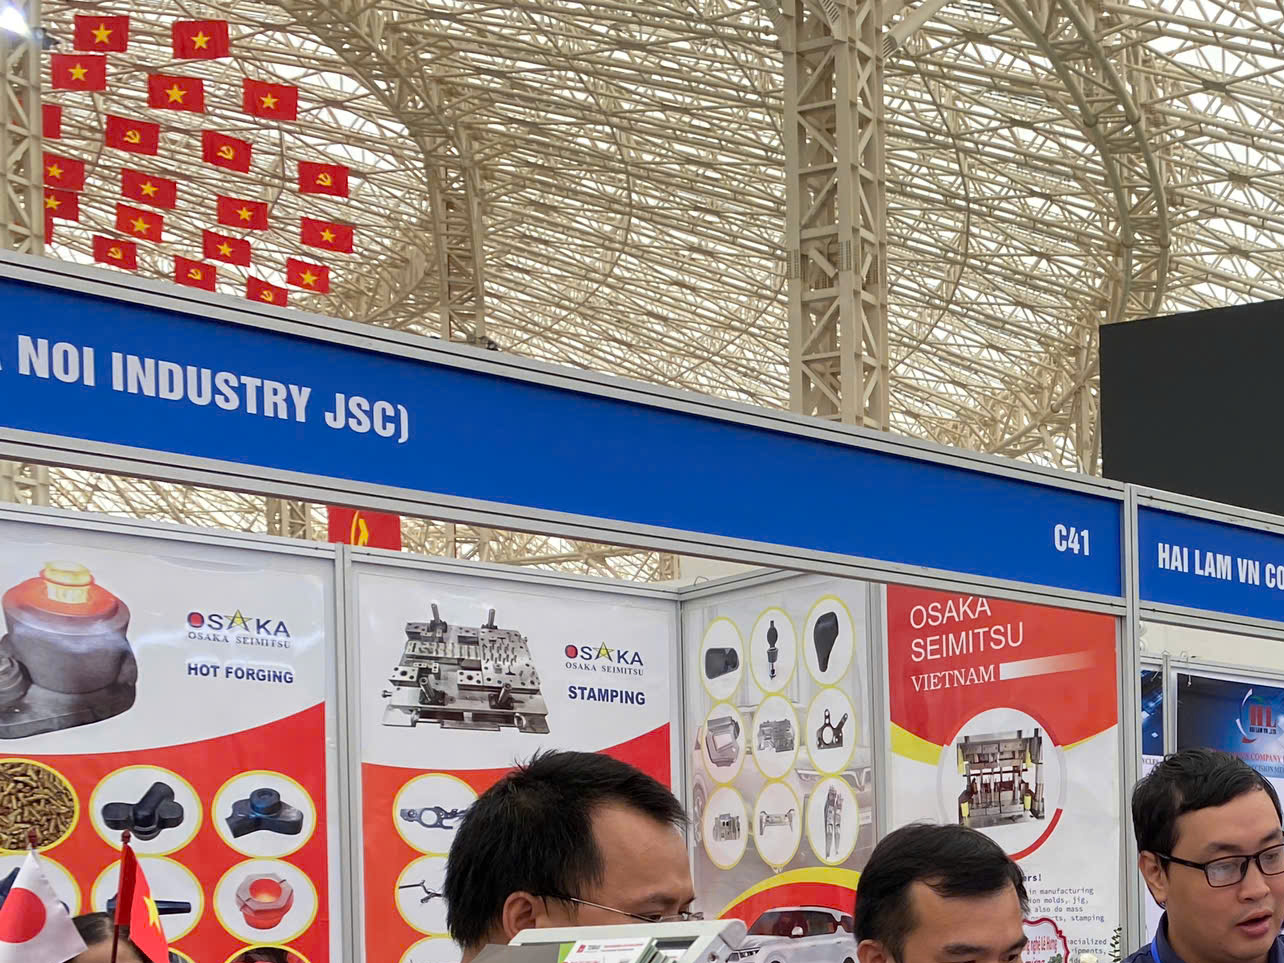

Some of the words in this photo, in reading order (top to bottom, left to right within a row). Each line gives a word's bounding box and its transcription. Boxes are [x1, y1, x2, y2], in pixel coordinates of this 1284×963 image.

[17, 335, 96, 387] NOI
[111, 352, 311, 423] INDUSTRY
[324, 393, 409, 444] JSC)
[1054, 523, 1090, 556] C41
[1158, 543, 1189, 573] HAI
[1194, 549, 1232, 581] LAM
[1237, 557, 1260, 585] VN
[910, 596, 992, 629] OSAKA
[188, 631, 229, 643] OSAKA
[236, 636, 291, 648] SEIMITSU
[911, 621, 1024, 662] SEIMITSU
[187, 663, 220, 677] HOT
[225, 666, 294, 683] FORGING
[565, 661, 597, 672] OSAKA
[601, 665, 644, 676] SEIMITSU
[911, 664, 995, 692] VIETNAM
[568, 685, 646, 705] STAMPING
[1040, 887, 1094, 895] manufacturing
[1071, 914, 1105, 922] stamping
